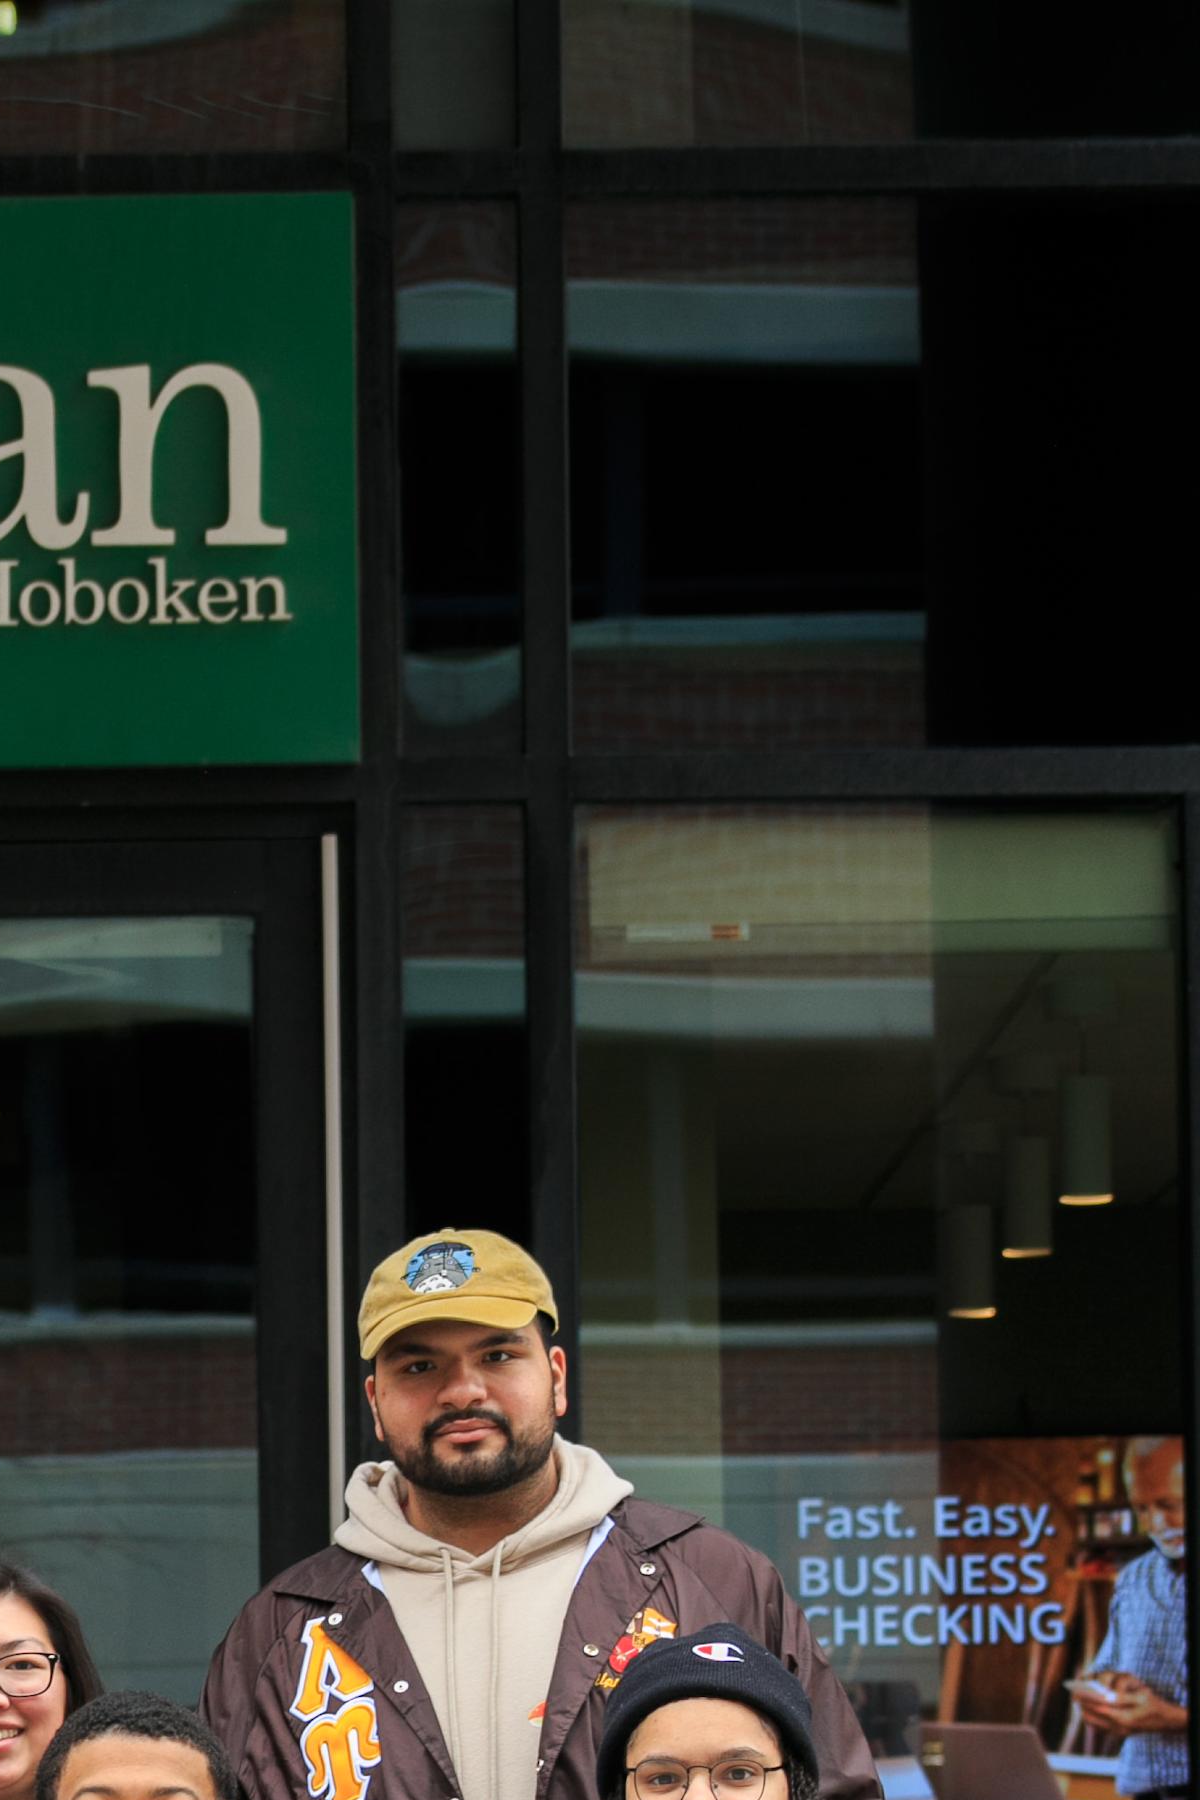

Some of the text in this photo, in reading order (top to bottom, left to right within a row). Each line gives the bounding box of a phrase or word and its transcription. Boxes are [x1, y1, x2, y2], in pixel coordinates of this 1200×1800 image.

[798, 1496, 1055, 1548] Fast. Easy.
[799, 1554, 1048, 1597] BUSINESS
